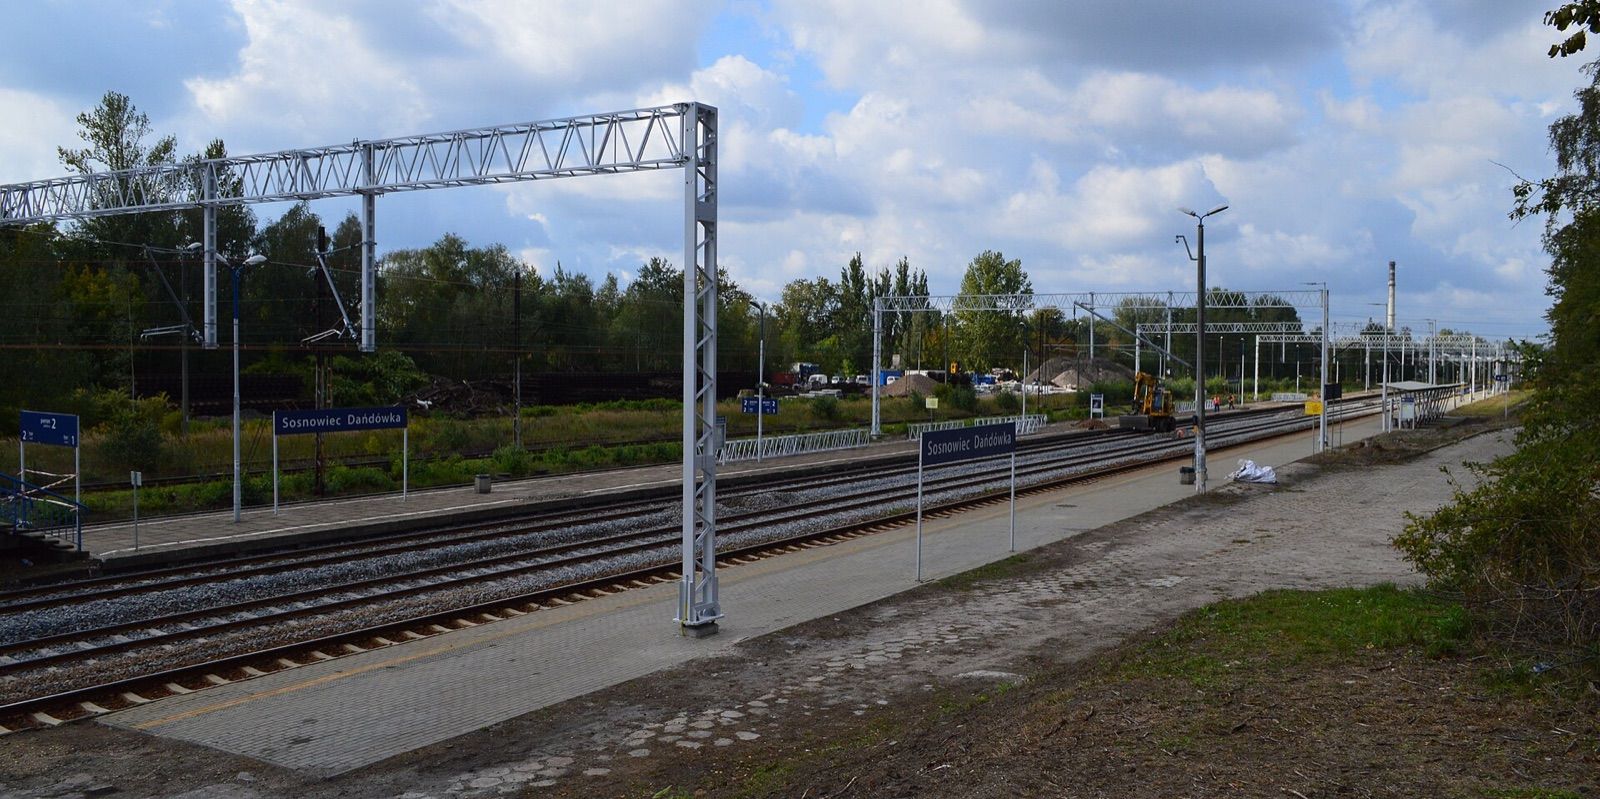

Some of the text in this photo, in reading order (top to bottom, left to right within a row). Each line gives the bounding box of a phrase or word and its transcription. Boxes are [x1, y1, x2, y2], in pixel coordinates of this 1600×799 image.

[51, 418, 56, 429] 2
[282, 412, 401, 428] Sosnowiec Dańdówka
[22, 430, 27, 440] 2
[927, 432, 1012, 456] Sosnowiec Dańdówka
